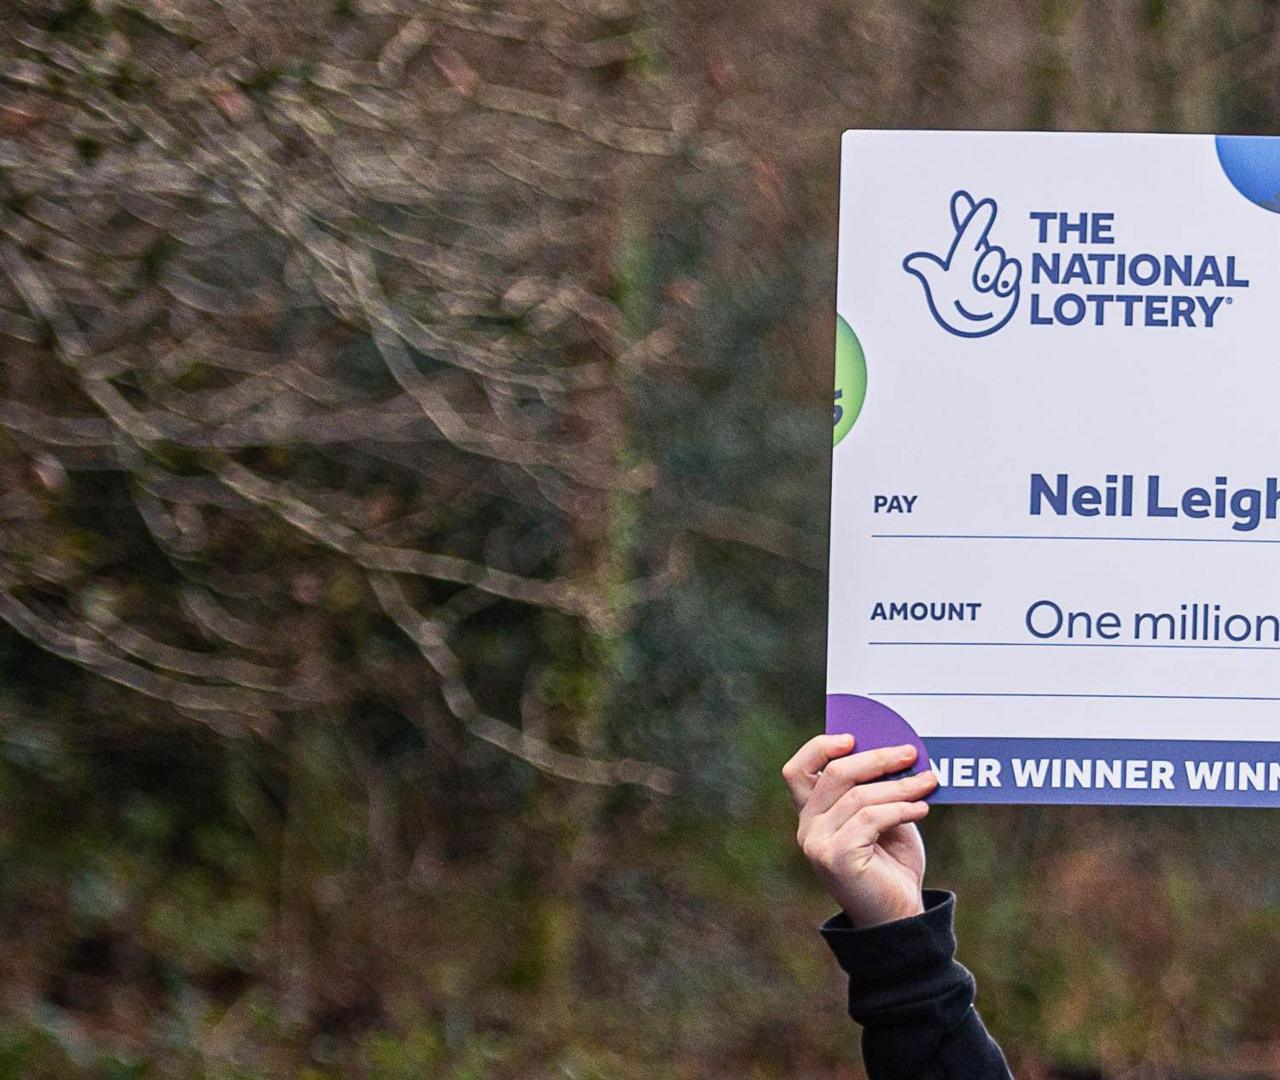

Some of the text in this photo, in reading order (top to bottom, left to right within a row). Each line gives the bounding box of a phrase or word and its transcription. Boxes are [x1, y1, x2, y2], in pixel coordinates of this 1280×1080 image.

[1029, 211, 1115, 245] THE
[1031, 252, 1250, 288] NATIONAL
[873, 495, 918, 514] PAY
[1029, 473, 1134, 517] Neil
[870, 602, 982, 621] AMOUNT
[1025, 599, 1122, 640] One
[1134, 603, 1280, 642] million
[930, 758, 1002, 787] NER
[1011, 758, 1175, 790] WINNER
